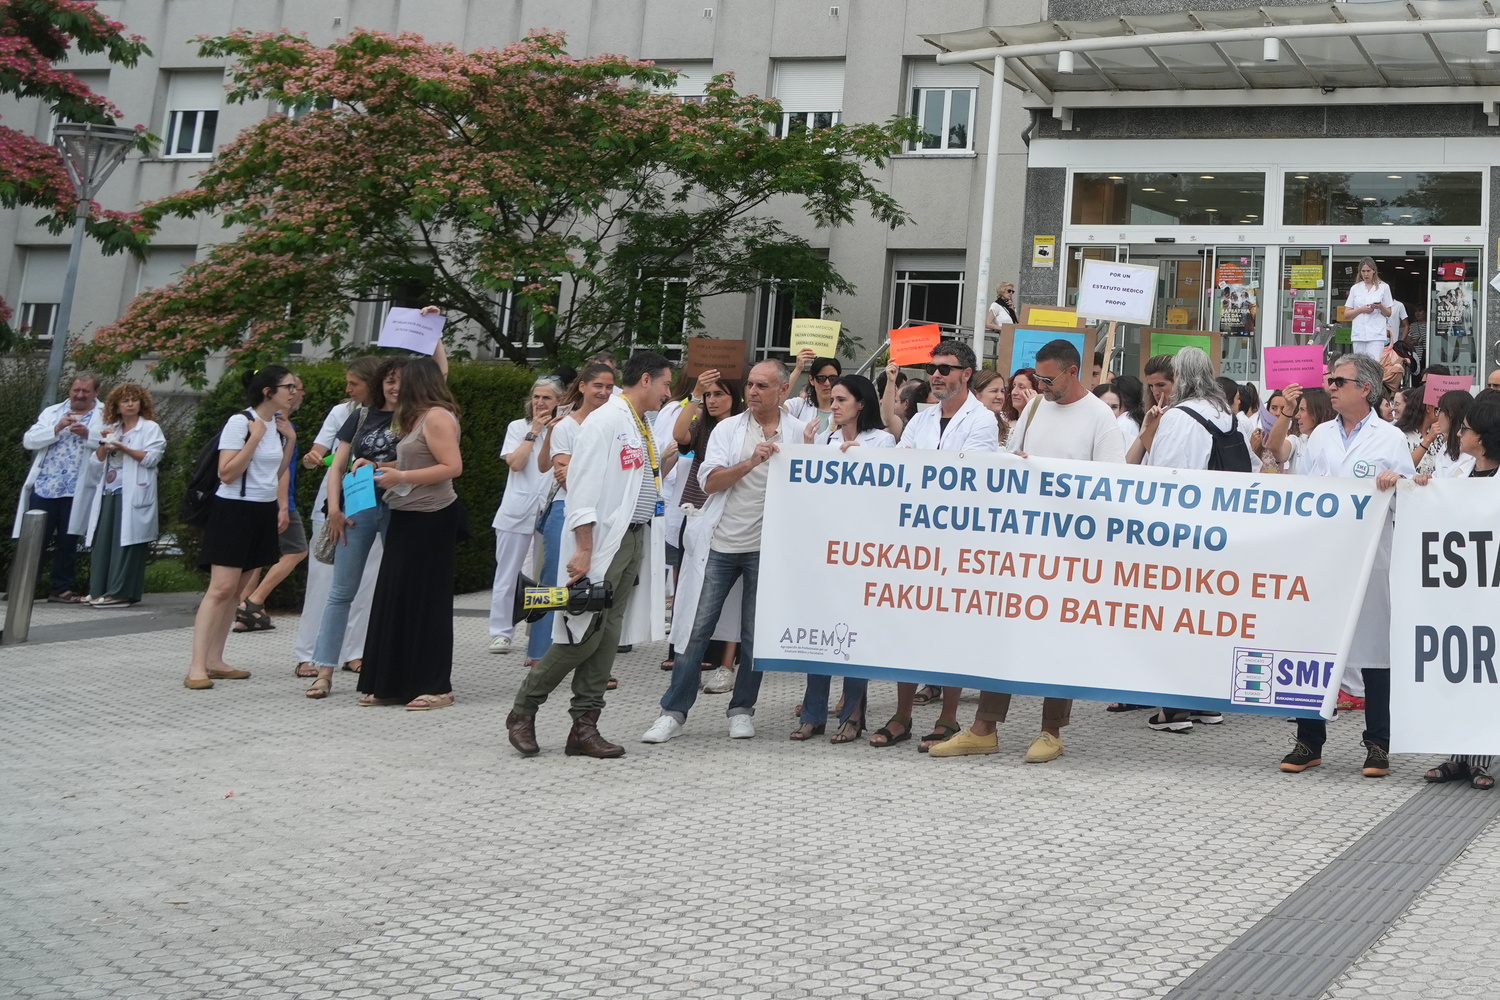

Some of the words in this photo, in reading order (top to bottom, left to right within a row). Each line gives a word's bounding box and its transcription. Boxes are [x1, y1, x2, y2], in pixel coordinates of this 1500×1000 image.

[1092, 284, 1121, 292] ESTATUTO
[789, 459, 912, 493] EUSKADI,
[921, 466, 977, 493] POR
[986, 469, 1029, 496] UN
[1039, 471, 1203, 511] ESTATUTO
[1211, 477, 1340, 518] MÉDICO
[1349, 494, 1372, 521] Y
[899, 503, 1096, 541] FACULTATIVO
[1106, 518, 1228, 552] PROPIO
[825, 540, 947, 577] EUSKADI,
[957, 549, 1104, 585] ESTATUTU
[1113, 562, 1239, 597] MEDIKO
[1250, 573, 1310, 602] ETA
[863, 582, 1049, 621] FAKULTATIBO
[1059, 598, 1164, 631] BATEN
[1173, 607, 1257, 640] ALDE
[1414, 625, 1498, 685] POR
